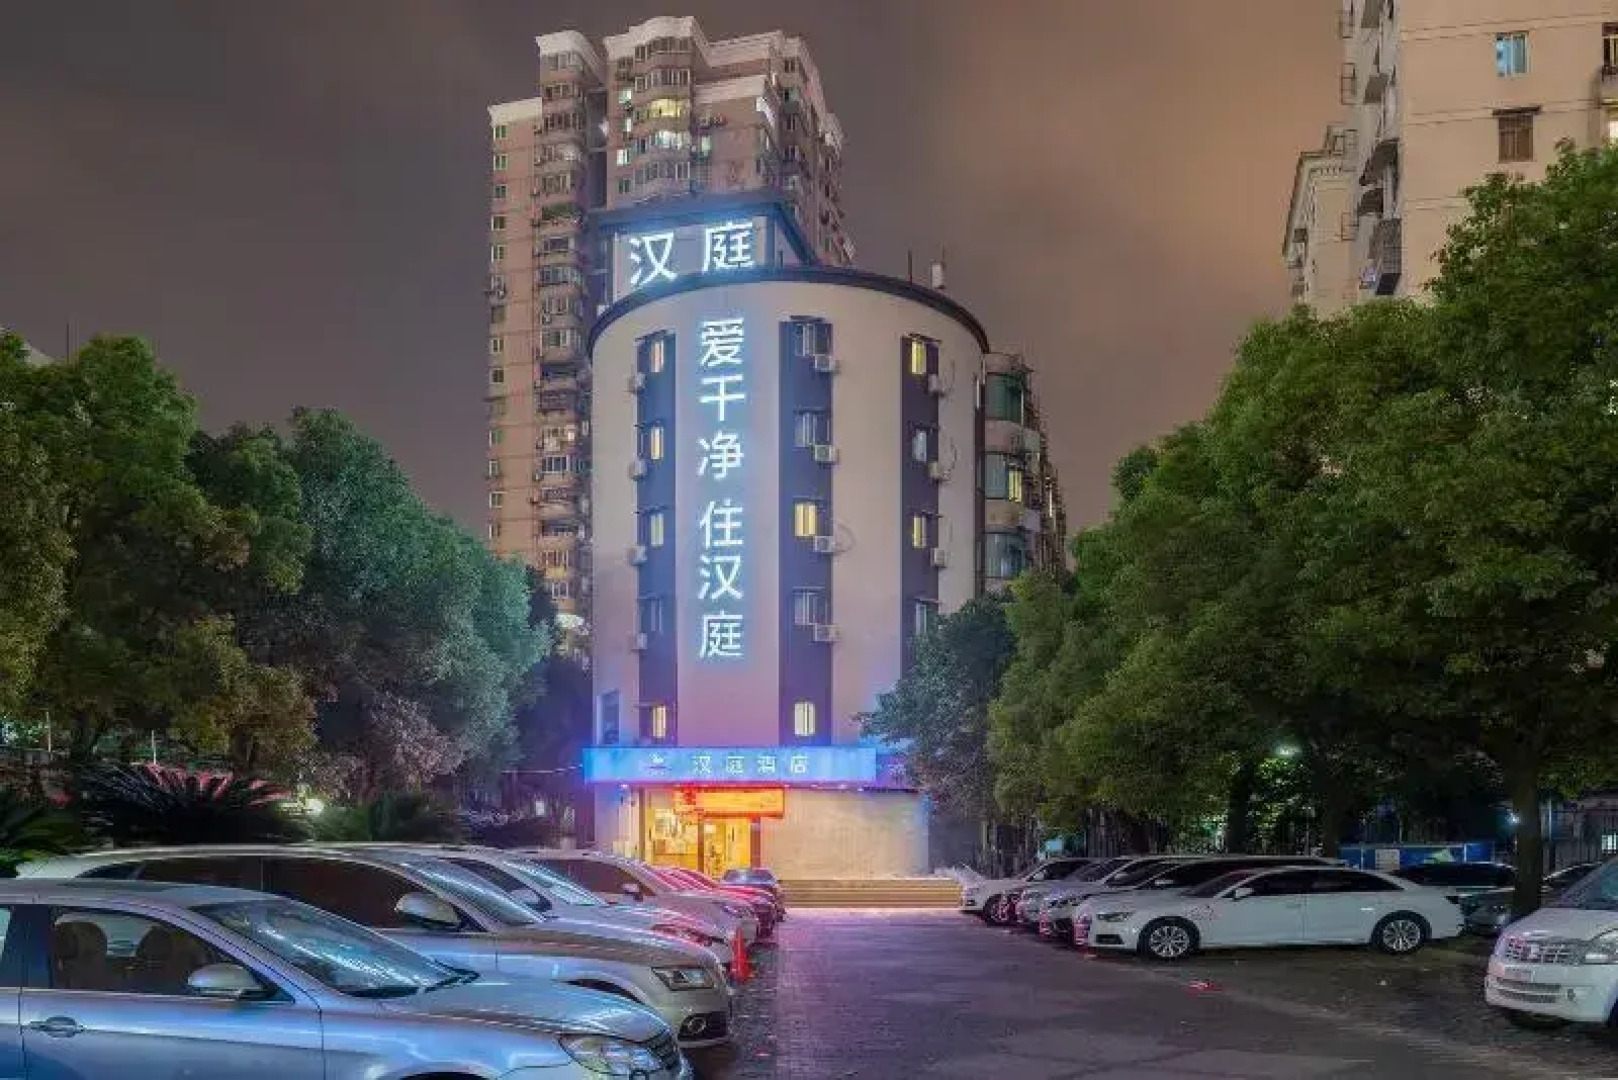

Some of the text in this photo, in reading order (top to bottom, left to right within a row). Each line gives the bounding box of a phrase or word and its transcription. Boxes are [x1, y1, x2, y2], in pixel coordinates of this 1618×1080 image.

[629, 220, 754, 291] 汉庭
[697, 317, 745, 659] 爱干净 住汉庭
[691, 754, 808, 774] 汉庭酒店
